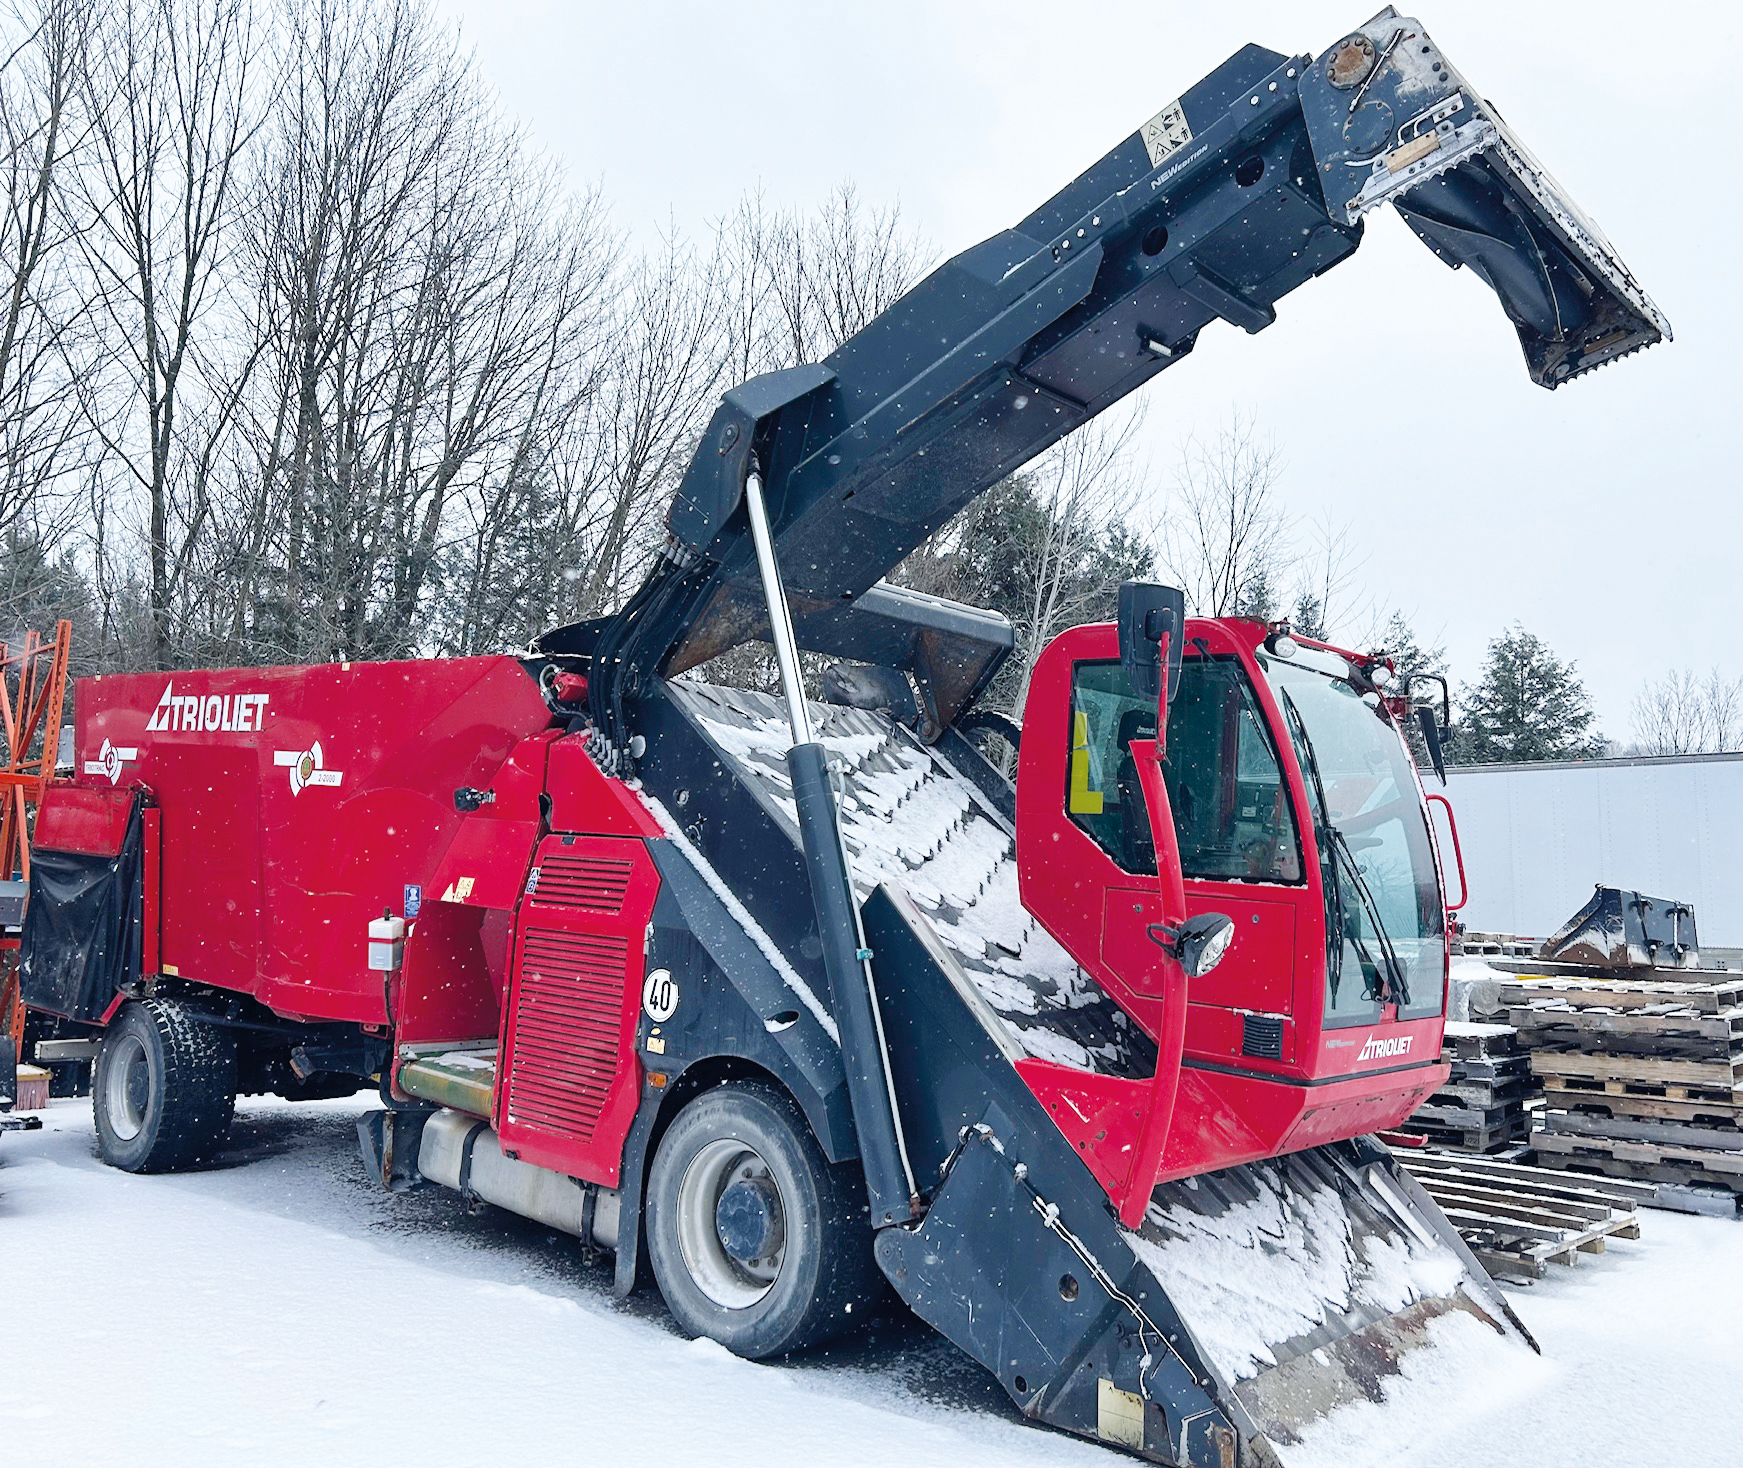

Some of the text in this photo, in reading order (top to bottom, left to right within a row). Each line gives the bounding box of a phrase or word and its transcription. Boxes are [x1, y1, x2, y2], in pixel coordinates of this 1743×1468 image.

[171, 693, 270, 732] TRIOLIET
[649, 978, 672, 1012] 40
[1370, 1035, 1414, 1060] TRIOLIET
